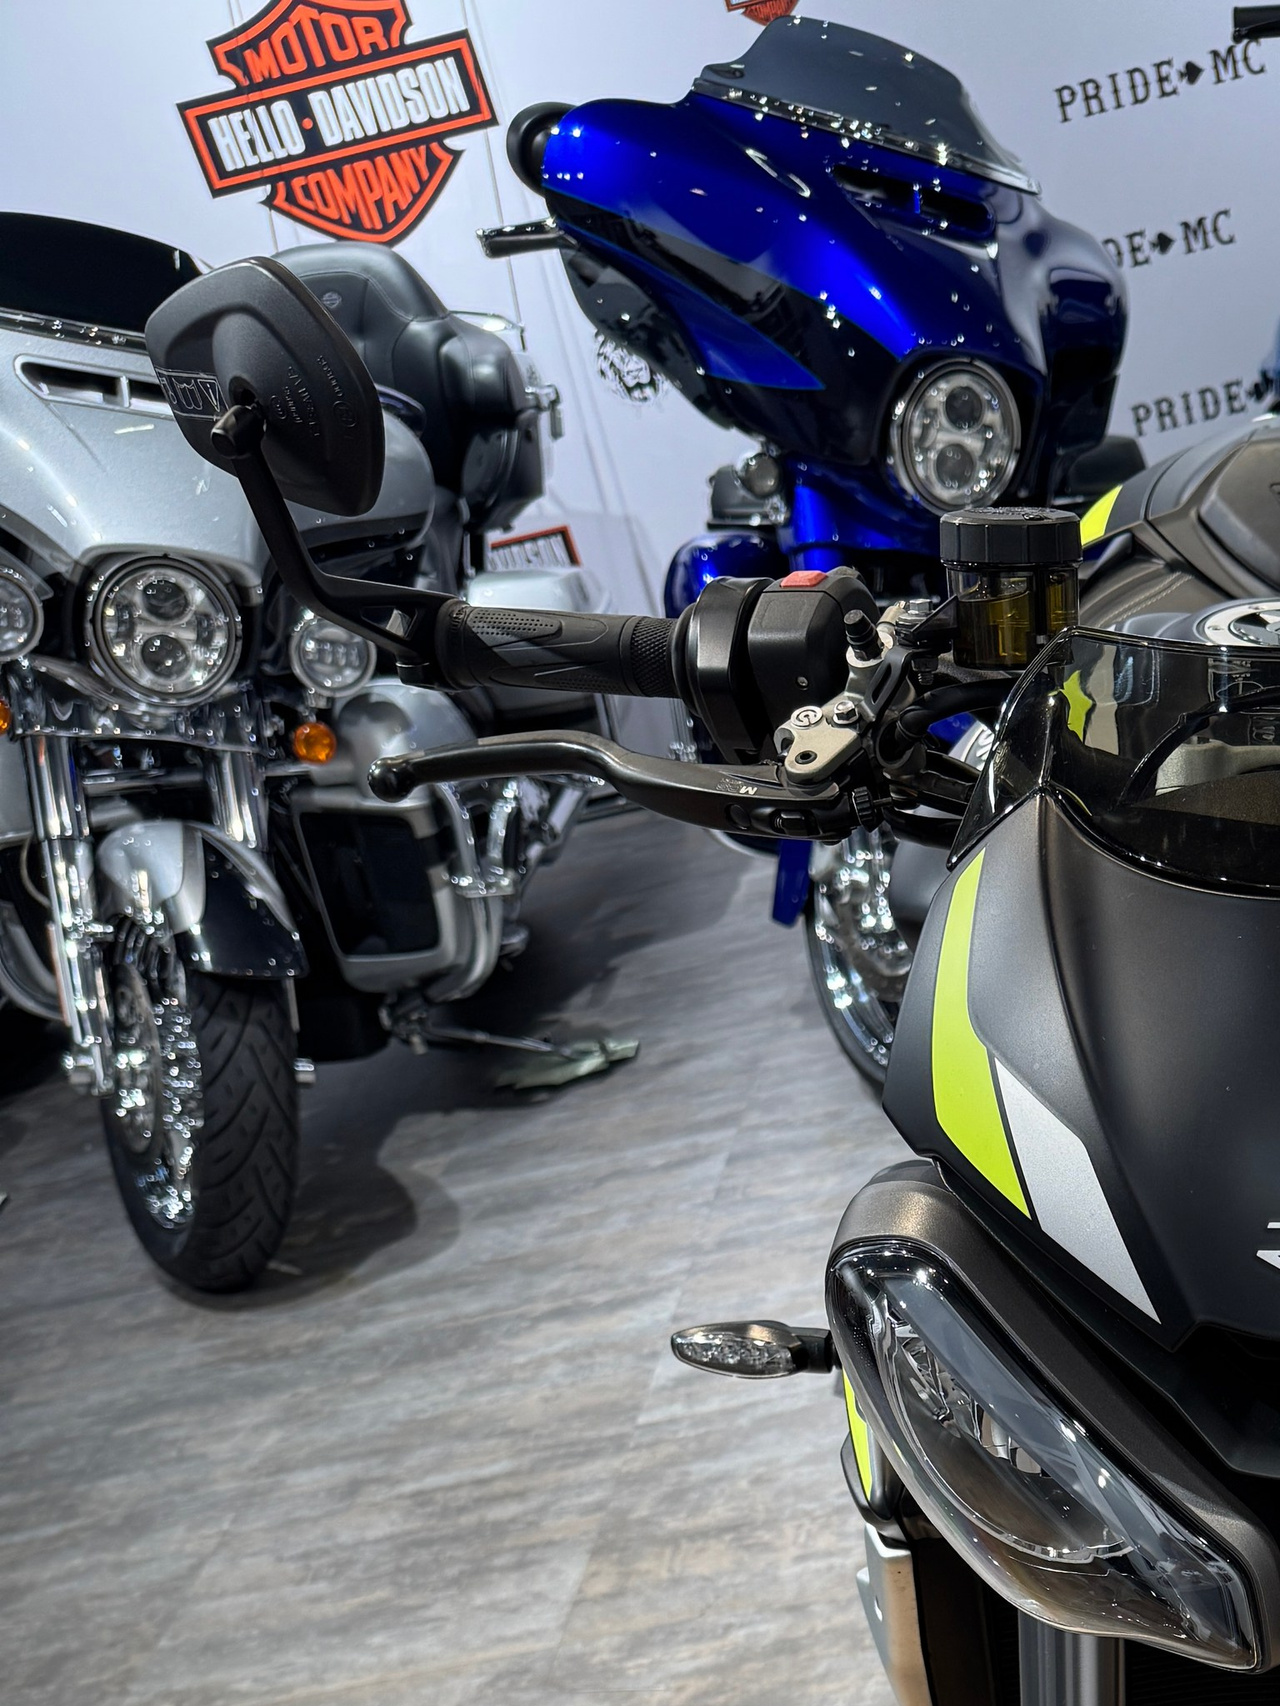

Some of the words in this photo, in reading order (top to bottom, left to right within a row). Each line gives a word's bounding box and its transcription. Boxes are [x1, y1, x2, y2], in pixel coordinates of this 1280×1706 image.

[244, 3, 389, 84] MOTOR
[1054, 58, 1180, 123] PRIDE
[1208, 39, 1267, 85] MC
[207, 99, 306, 172] HELLO
[307, 56, 471, 147] DAVIDSON
[291, 144, 430, 230] COMPANY
[1179, 208, 1237, 255] MC
[1130, 378, 1247, 437] PRIDE
